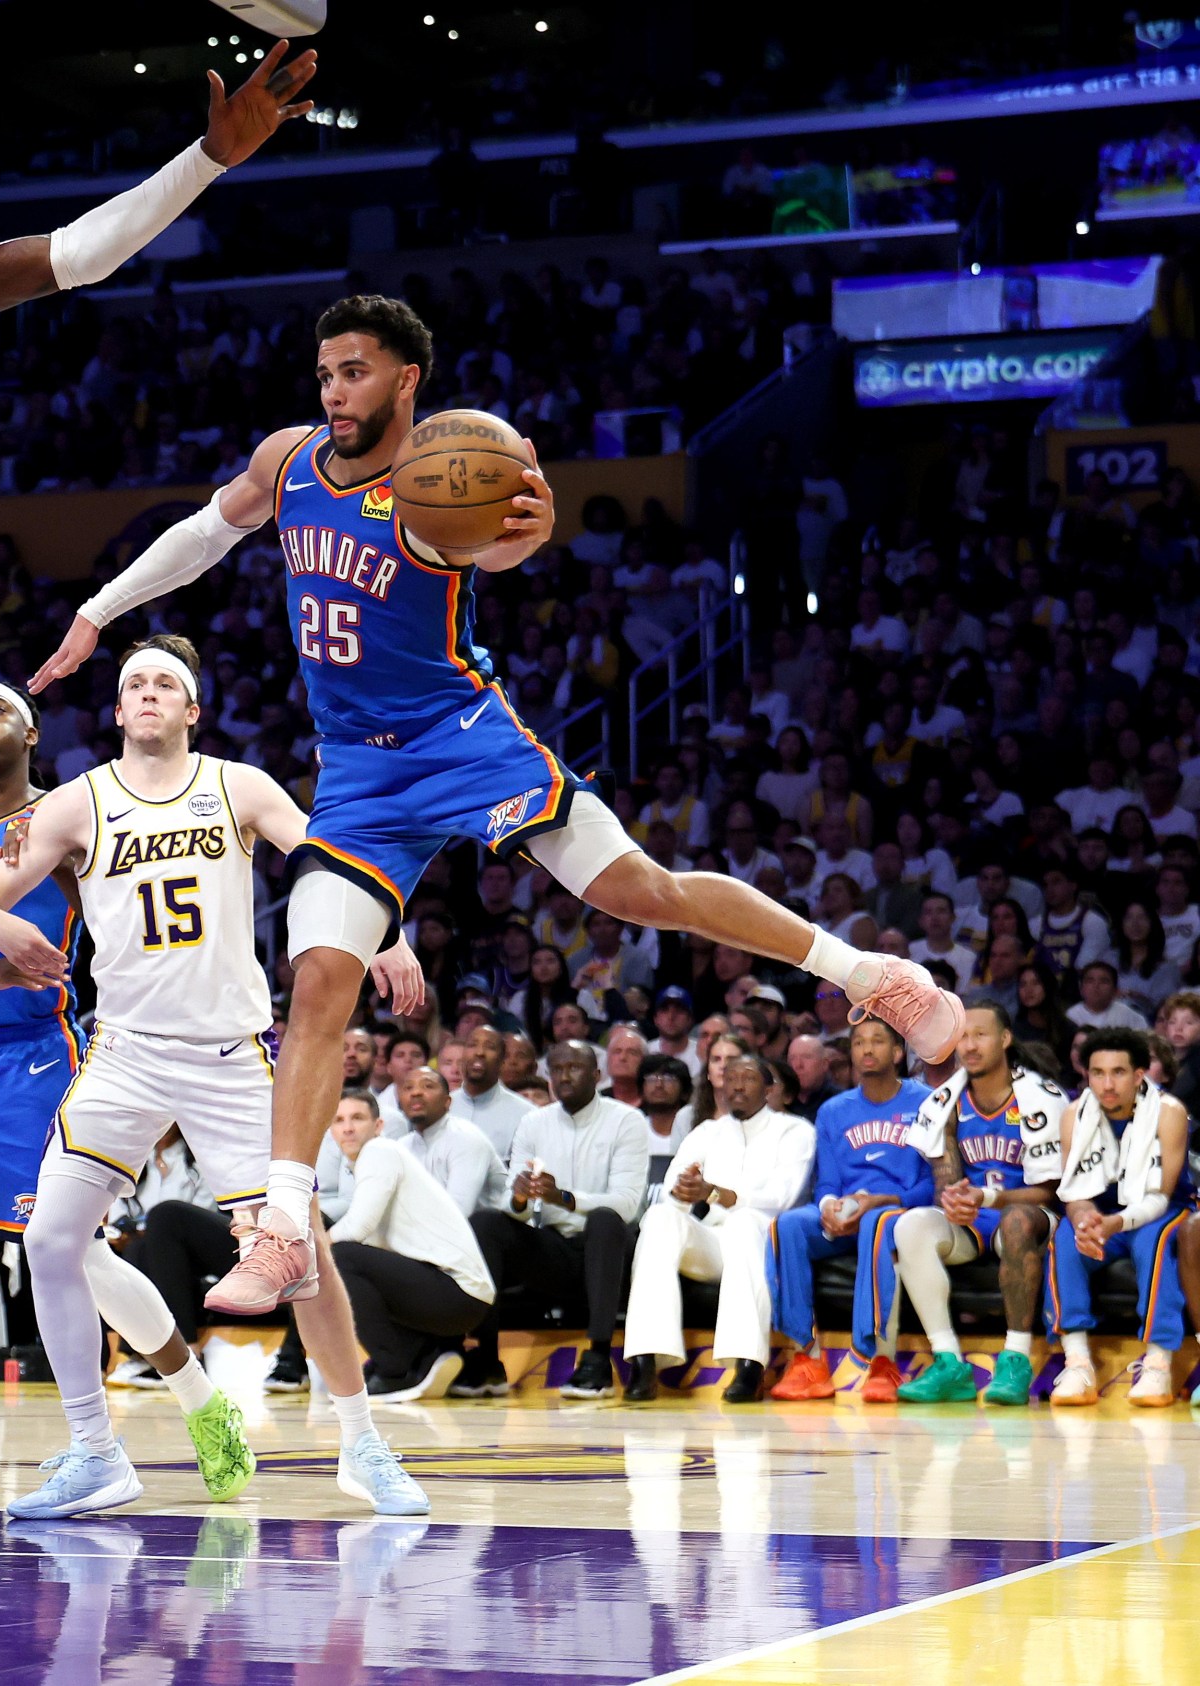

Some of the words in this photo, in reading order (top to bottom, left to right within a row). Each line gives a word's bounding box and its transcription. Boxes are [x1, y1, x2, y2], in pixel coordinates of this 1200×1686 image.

[411, 419, 506, 449] Wilson
[1076, 447, 1159, 488] 102
[279, 526, 400, 601] THUNDER
[299, 595, 361, 667] 25
[191, 799, 220, 809] bibigo
[104, 826, 227, 879] LAKERS
[138, 875, 204, 951] 15
[844, 1119, 912, 1150] THUNDER
[960, 1135, 1026, 1165] HUNDE
